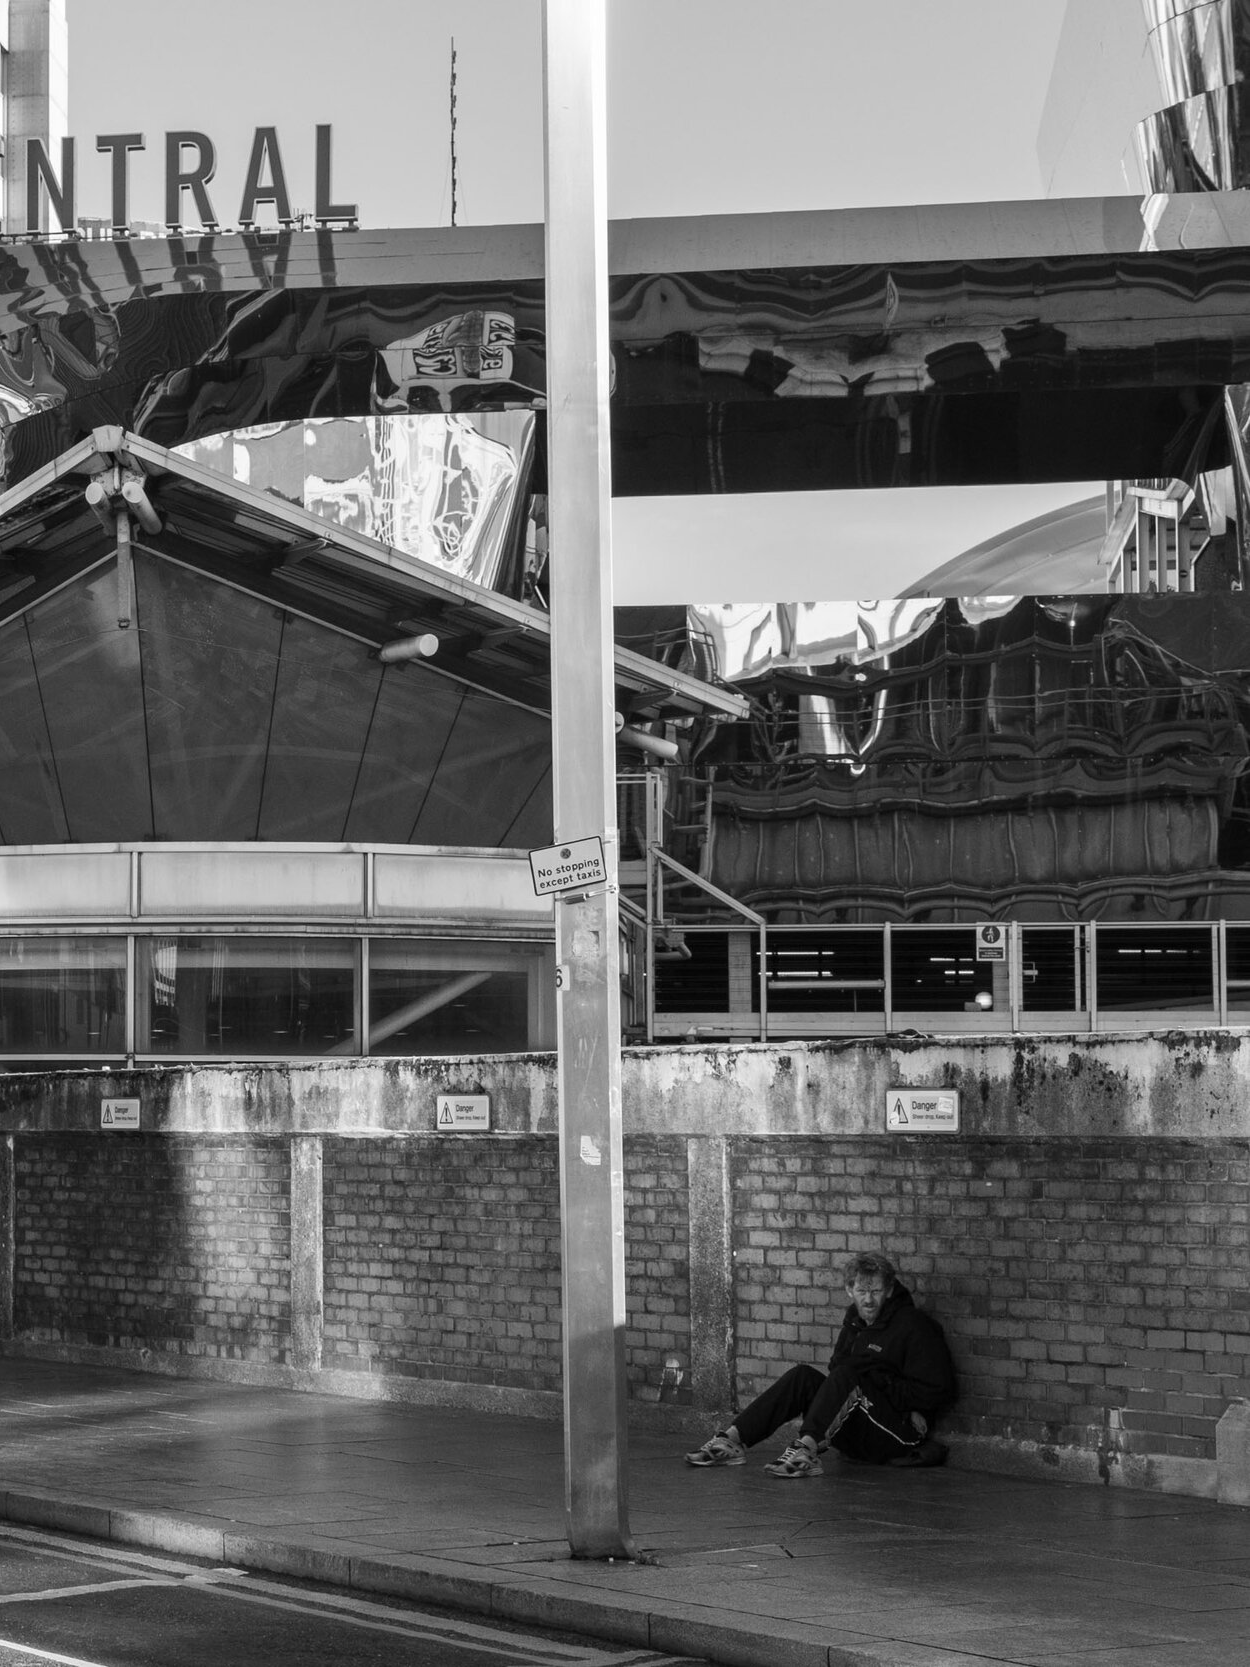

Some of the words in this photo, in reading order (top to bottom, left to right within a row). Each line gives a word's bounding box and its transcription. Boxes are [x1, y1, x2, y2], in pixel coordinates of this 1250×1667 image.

[537, 868, 553, 878] No
[556, 858, 600, 873] stopping
[539, 874, 574, 889] except
[577, 868, 602, 881] taxis
[456, 1104, 474, 1114] Danger
[912, 1100, 938, 1112] Danger
